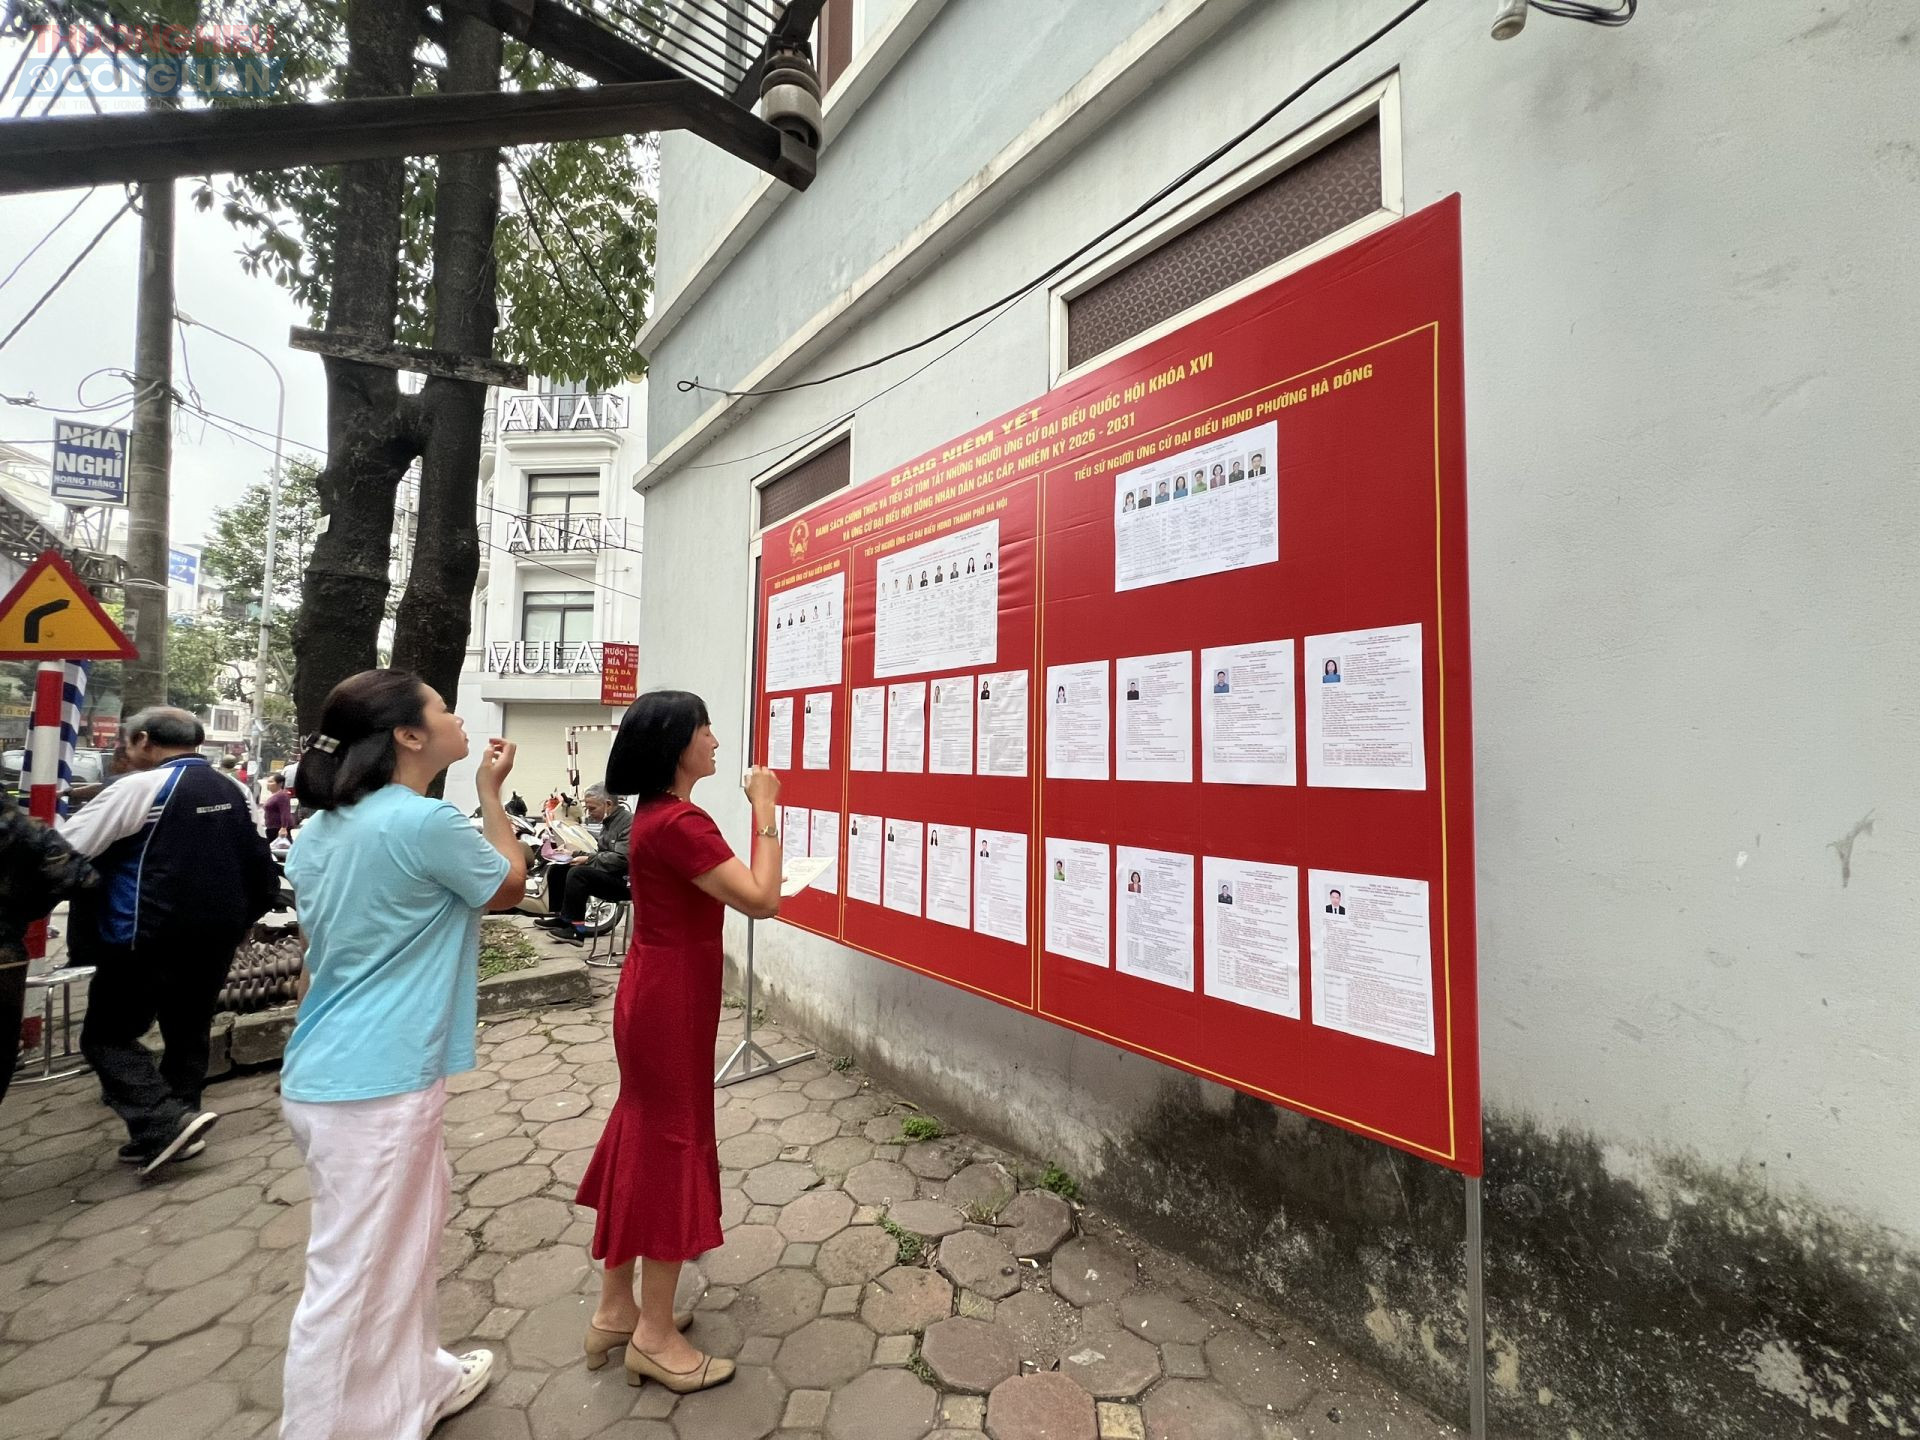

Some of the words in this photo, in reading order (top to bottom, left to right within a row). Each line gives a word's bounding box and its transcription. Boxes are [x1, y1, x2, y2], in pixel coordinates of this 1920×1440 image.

[1041, 420, 1059, 440] ĐẠI
[1061, 405, 1086, 432] BIỂU
[1089, 390, 1121, 420] QUỐC
[1124, 381, 1145, 405] HỘI
[1149, 366, 1186, 395] KHÓA
[1189, 351, 1214, 377] XVI
[1158, 436, 1173, 453] CỬ
[1174, 429, 1192, 446] ĐẠI
[1194, 416, 1219, 439] BIỂU
[1221, 407, 1253, 430] HĐND
[1256, 387, 1307, 418] PHƯỜNG
[1311, 377, 1330, 399] HÀ
[1333, 363, 1373, 390] ĐÔNG
[58, 424, 122, 453] NHÀ
[1068, 430, 1096, 451] 2026
[1107, 411, 1136, 436] 2031
[56, 451, 123, 478] NGHỈ
